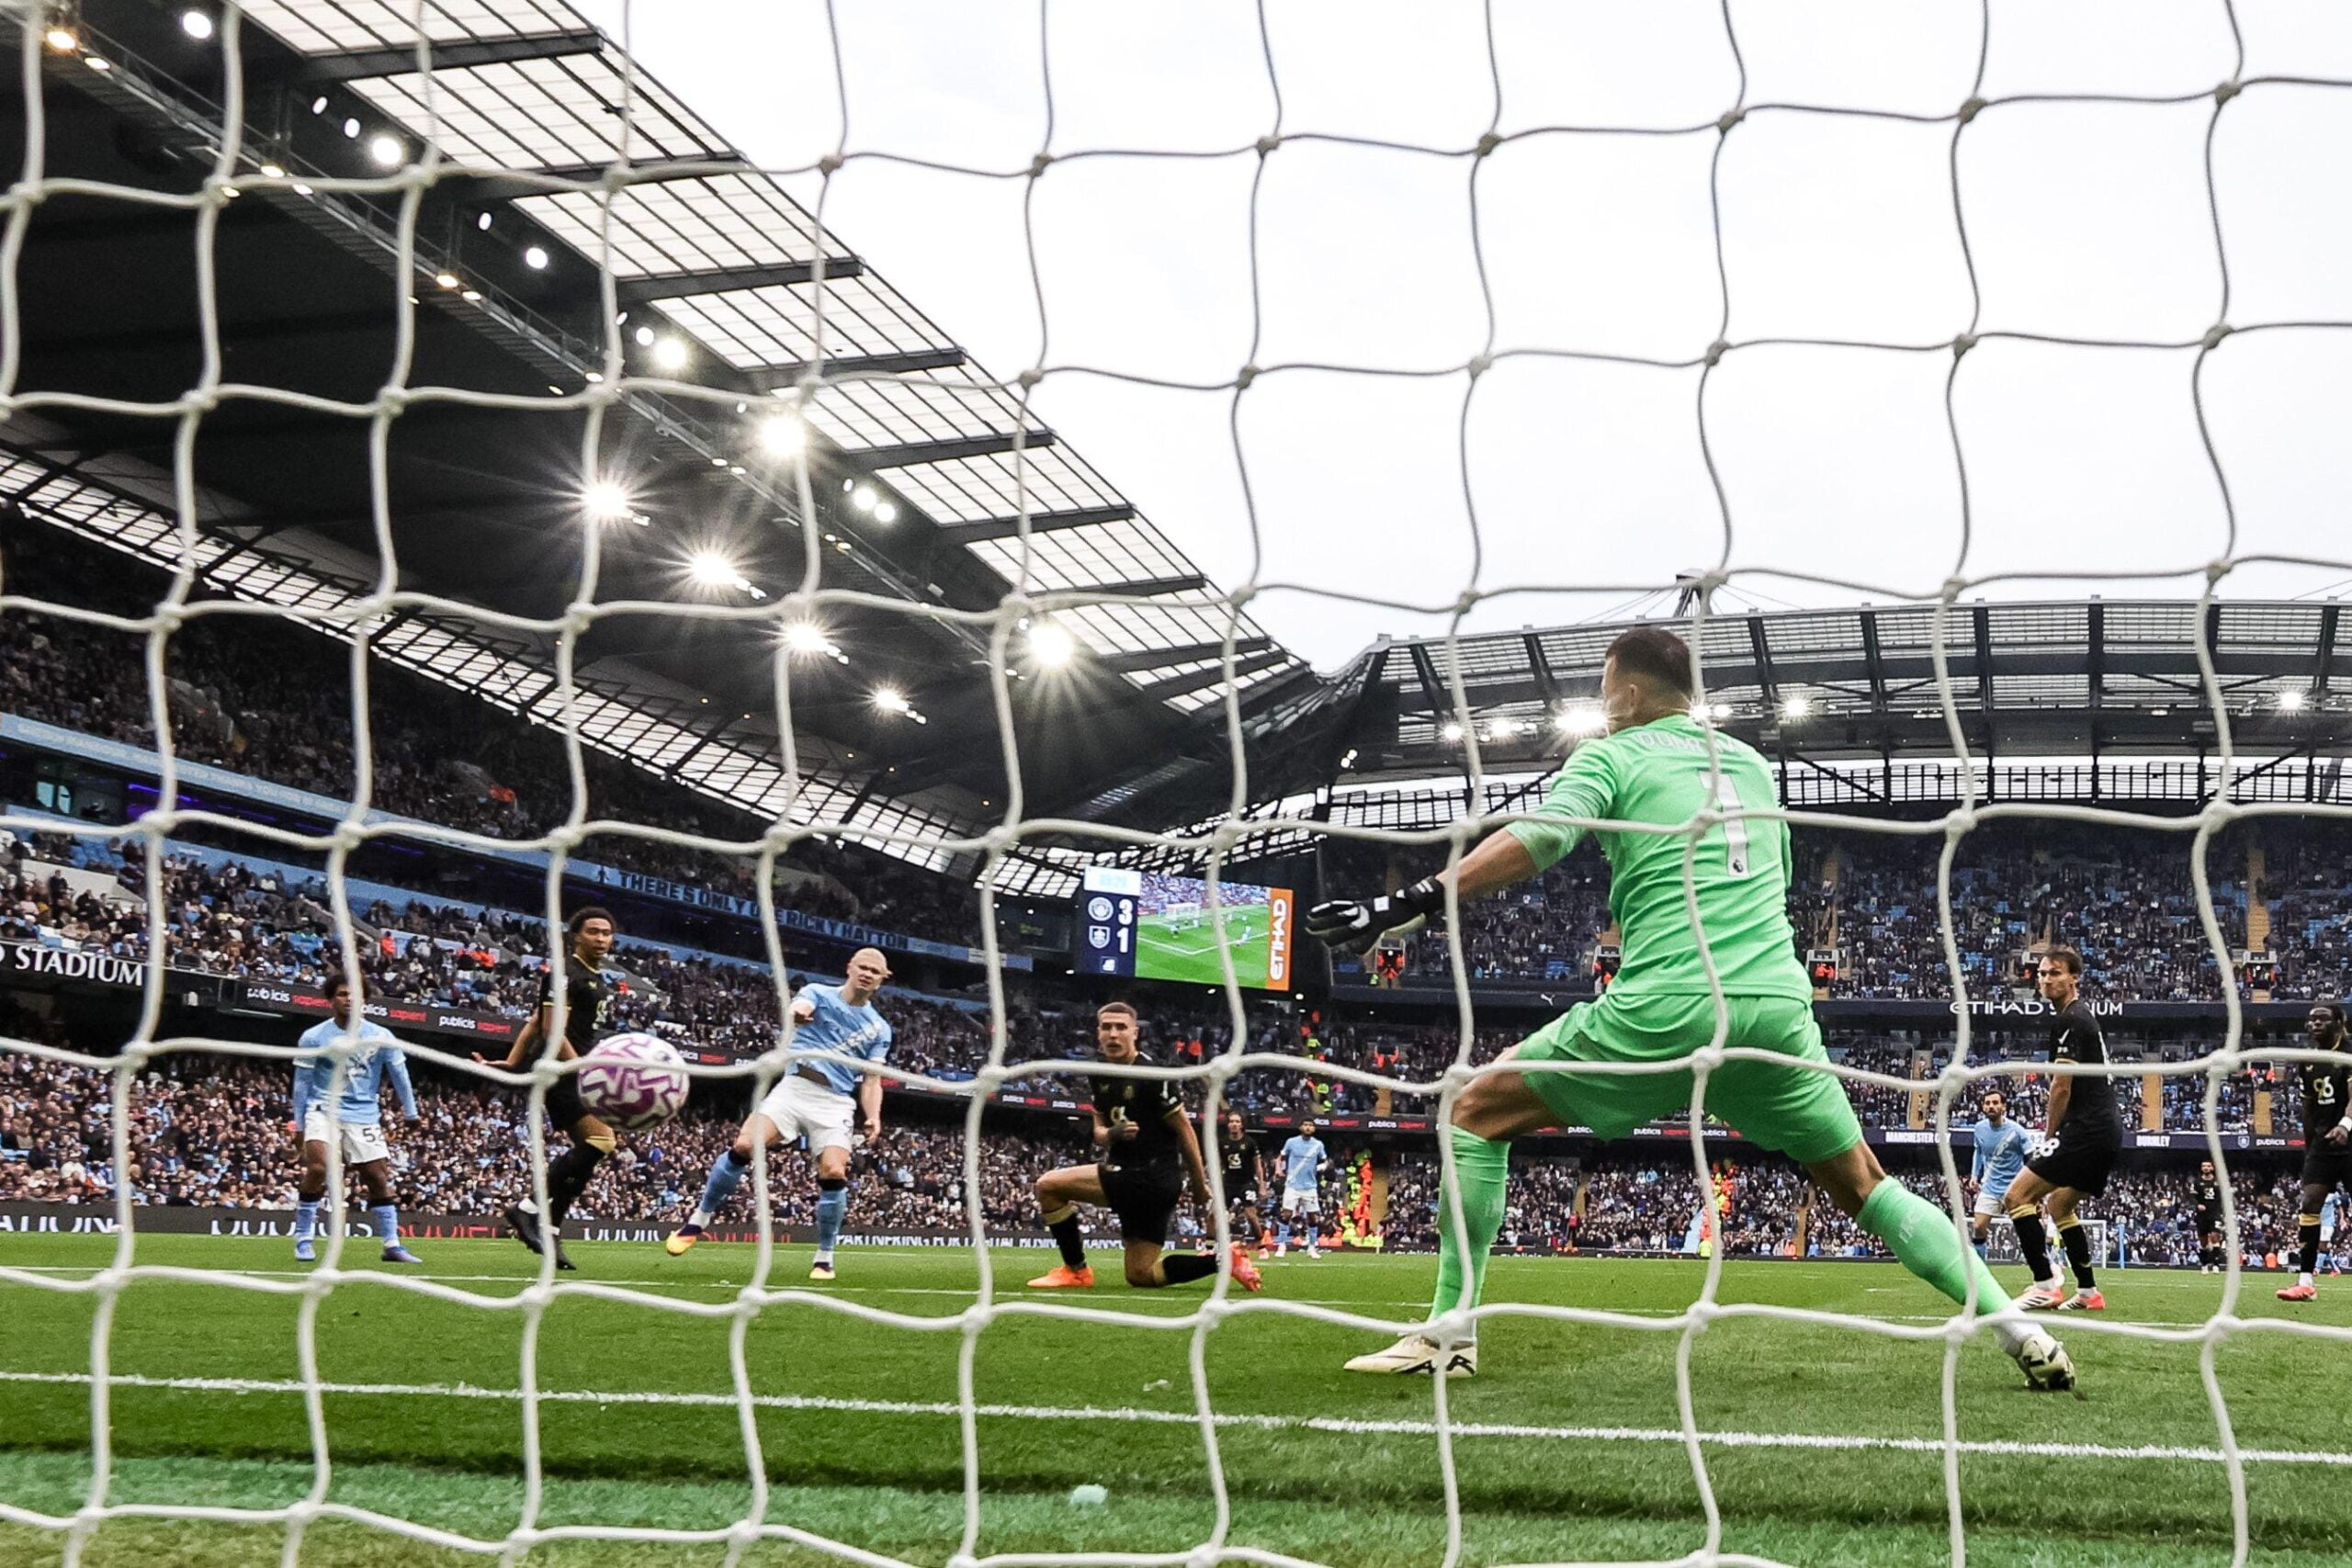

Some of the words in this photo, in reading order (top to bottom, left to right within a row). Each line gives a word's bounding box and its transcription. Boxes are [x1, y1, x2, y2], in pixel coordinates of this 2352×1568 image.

[1698, 771, 1749, 876] 1
[750, 901, 788, 926] OE
[841, 923, 909, 950] HATTON
[1117, 897, 1134, 925] 3
[1116, 927, 1129, 953] 1
[1269, 897, 1287, 981] ETIHAD
[15, 944, 143, 987] STADIUM
[438, 1014, 476, 1030] publicis
[2313, 1076, 2335, 1099] 96
